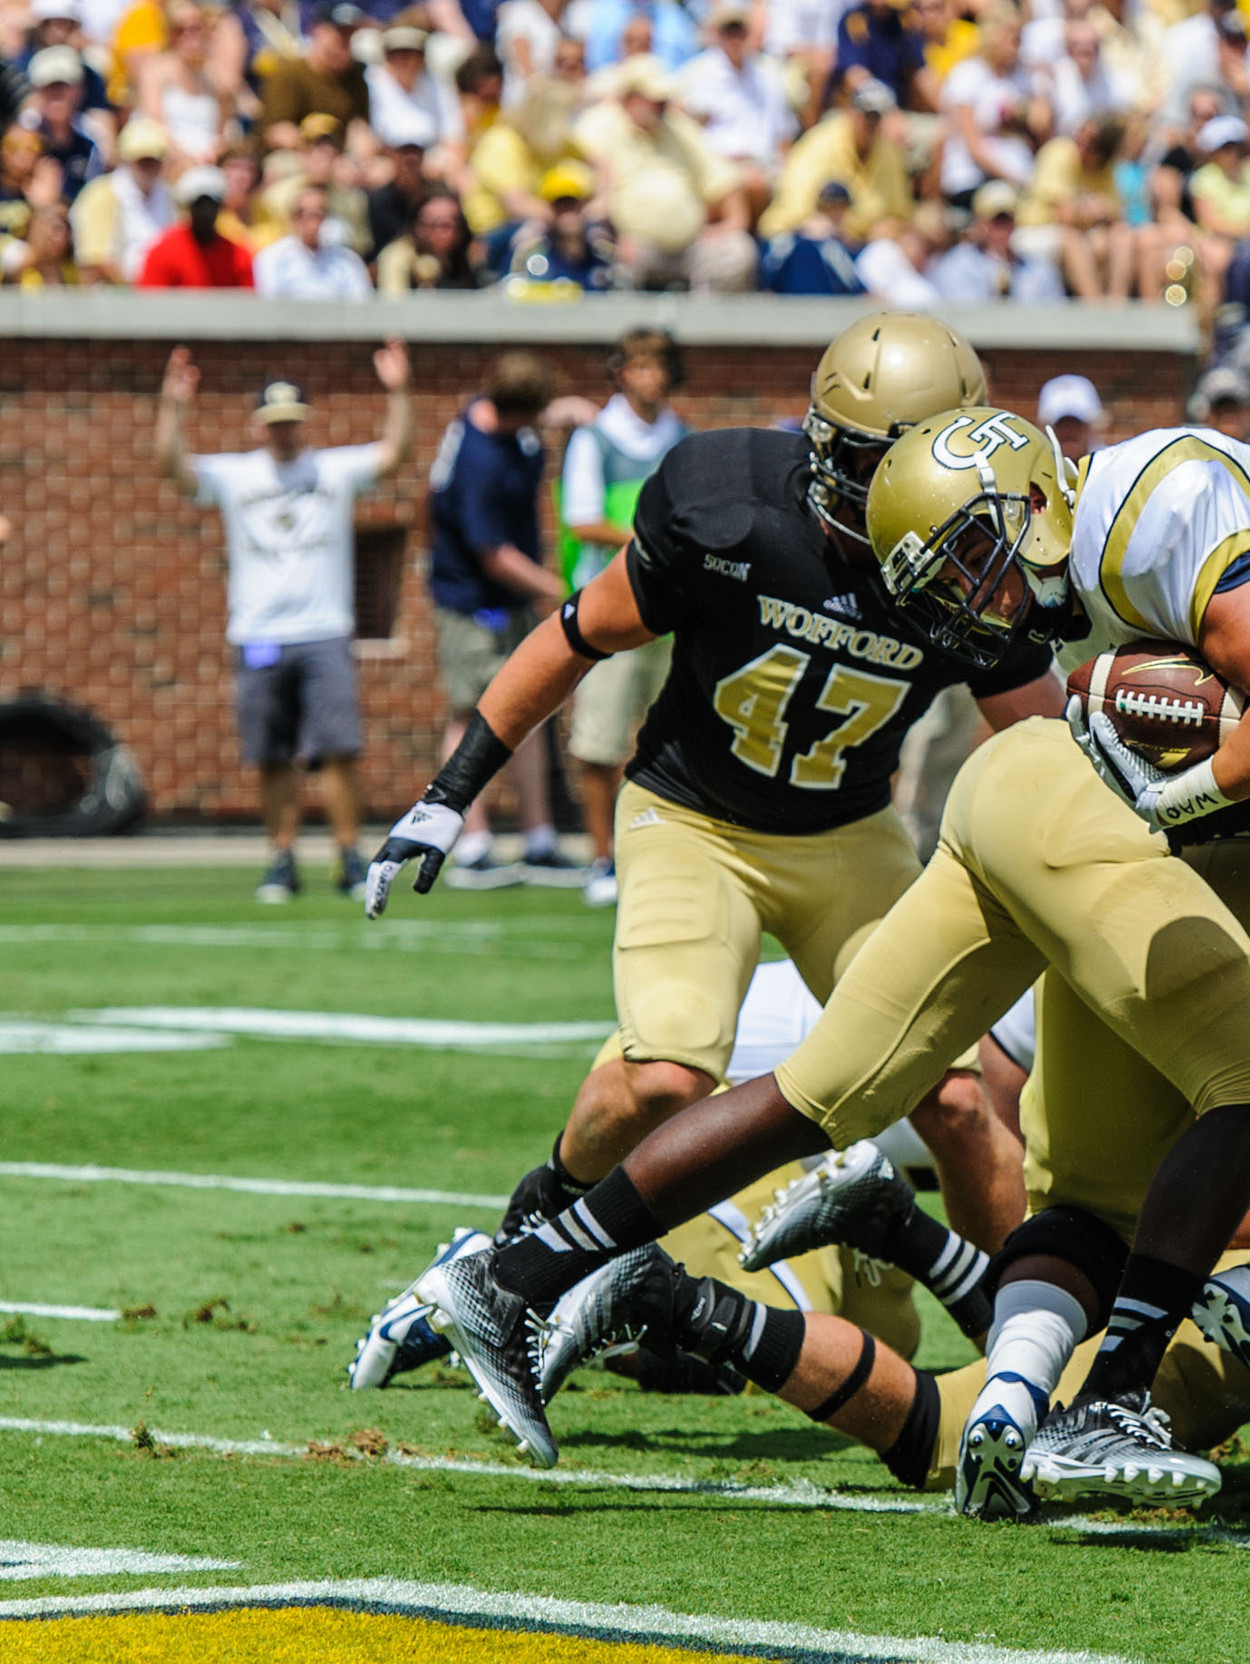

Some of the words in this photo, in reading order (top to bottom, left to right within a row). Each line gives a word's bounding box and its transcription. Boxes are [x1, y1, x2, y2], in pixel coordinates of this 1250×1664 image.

[702, 553, 751, 582] SOCON
[757, 594, 924, 670] WOFFORD
[713, 643, 912, 790] 47
